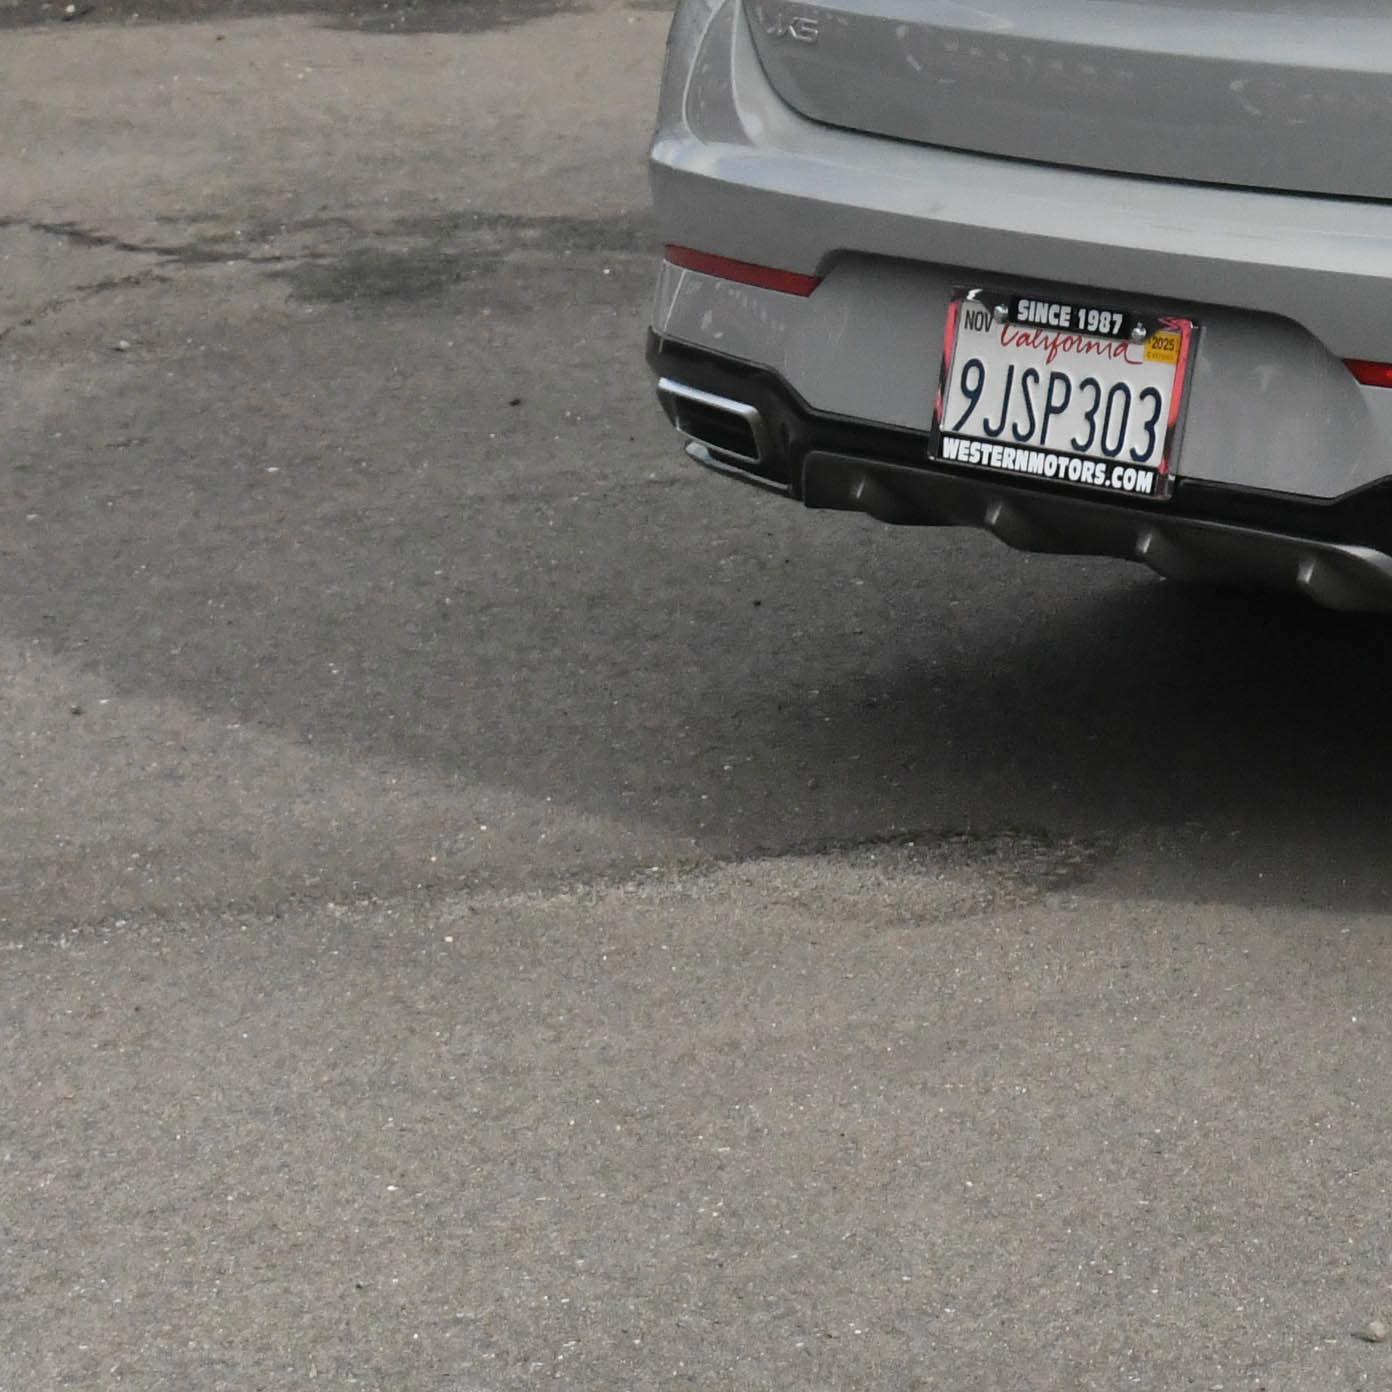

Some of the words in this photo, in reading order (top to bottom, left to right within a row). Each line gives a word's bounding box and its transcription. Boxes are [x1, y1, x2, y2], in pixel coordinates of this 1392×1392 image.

[964, 310, 993, 333] NOV
[1017, 299, 1072, 328] SINCE
[1078, 308, 1124, 335] 1987
[1000, 324, 1143, 365] California
[1151, 336, 1175, 351] 2025
[952, 358, 1162, 463] 9JSP303
[942, 436, 1155, 494] WESTERNMOTORS.COM
